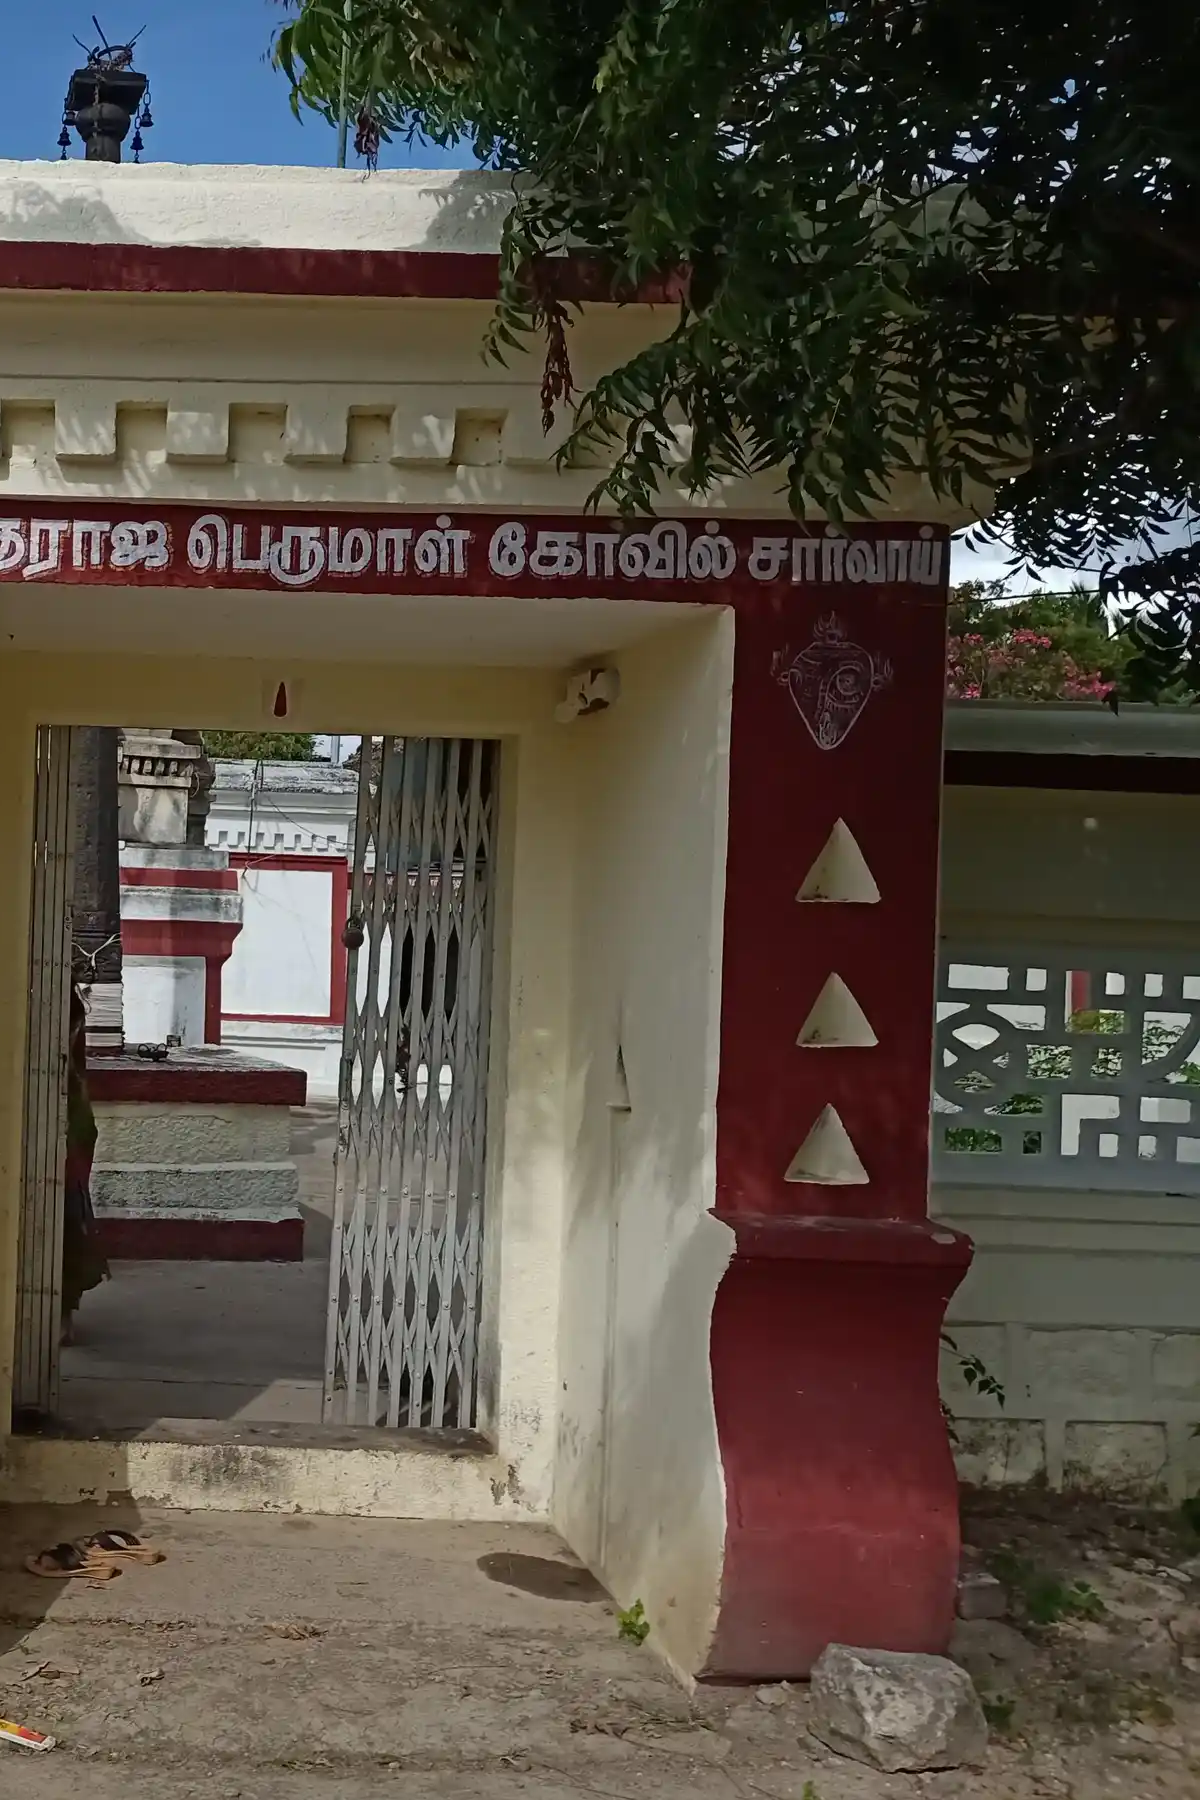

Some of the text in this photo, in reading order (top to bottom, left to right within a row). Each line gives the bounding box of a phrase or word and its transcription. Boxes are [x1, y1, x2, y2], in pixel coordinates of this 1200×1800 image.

[188, 514, 471, 585] பெருமாள்
[488, 520, 737, 580] கோவில்
[747, 523, 943, 585] சார்வாய்
